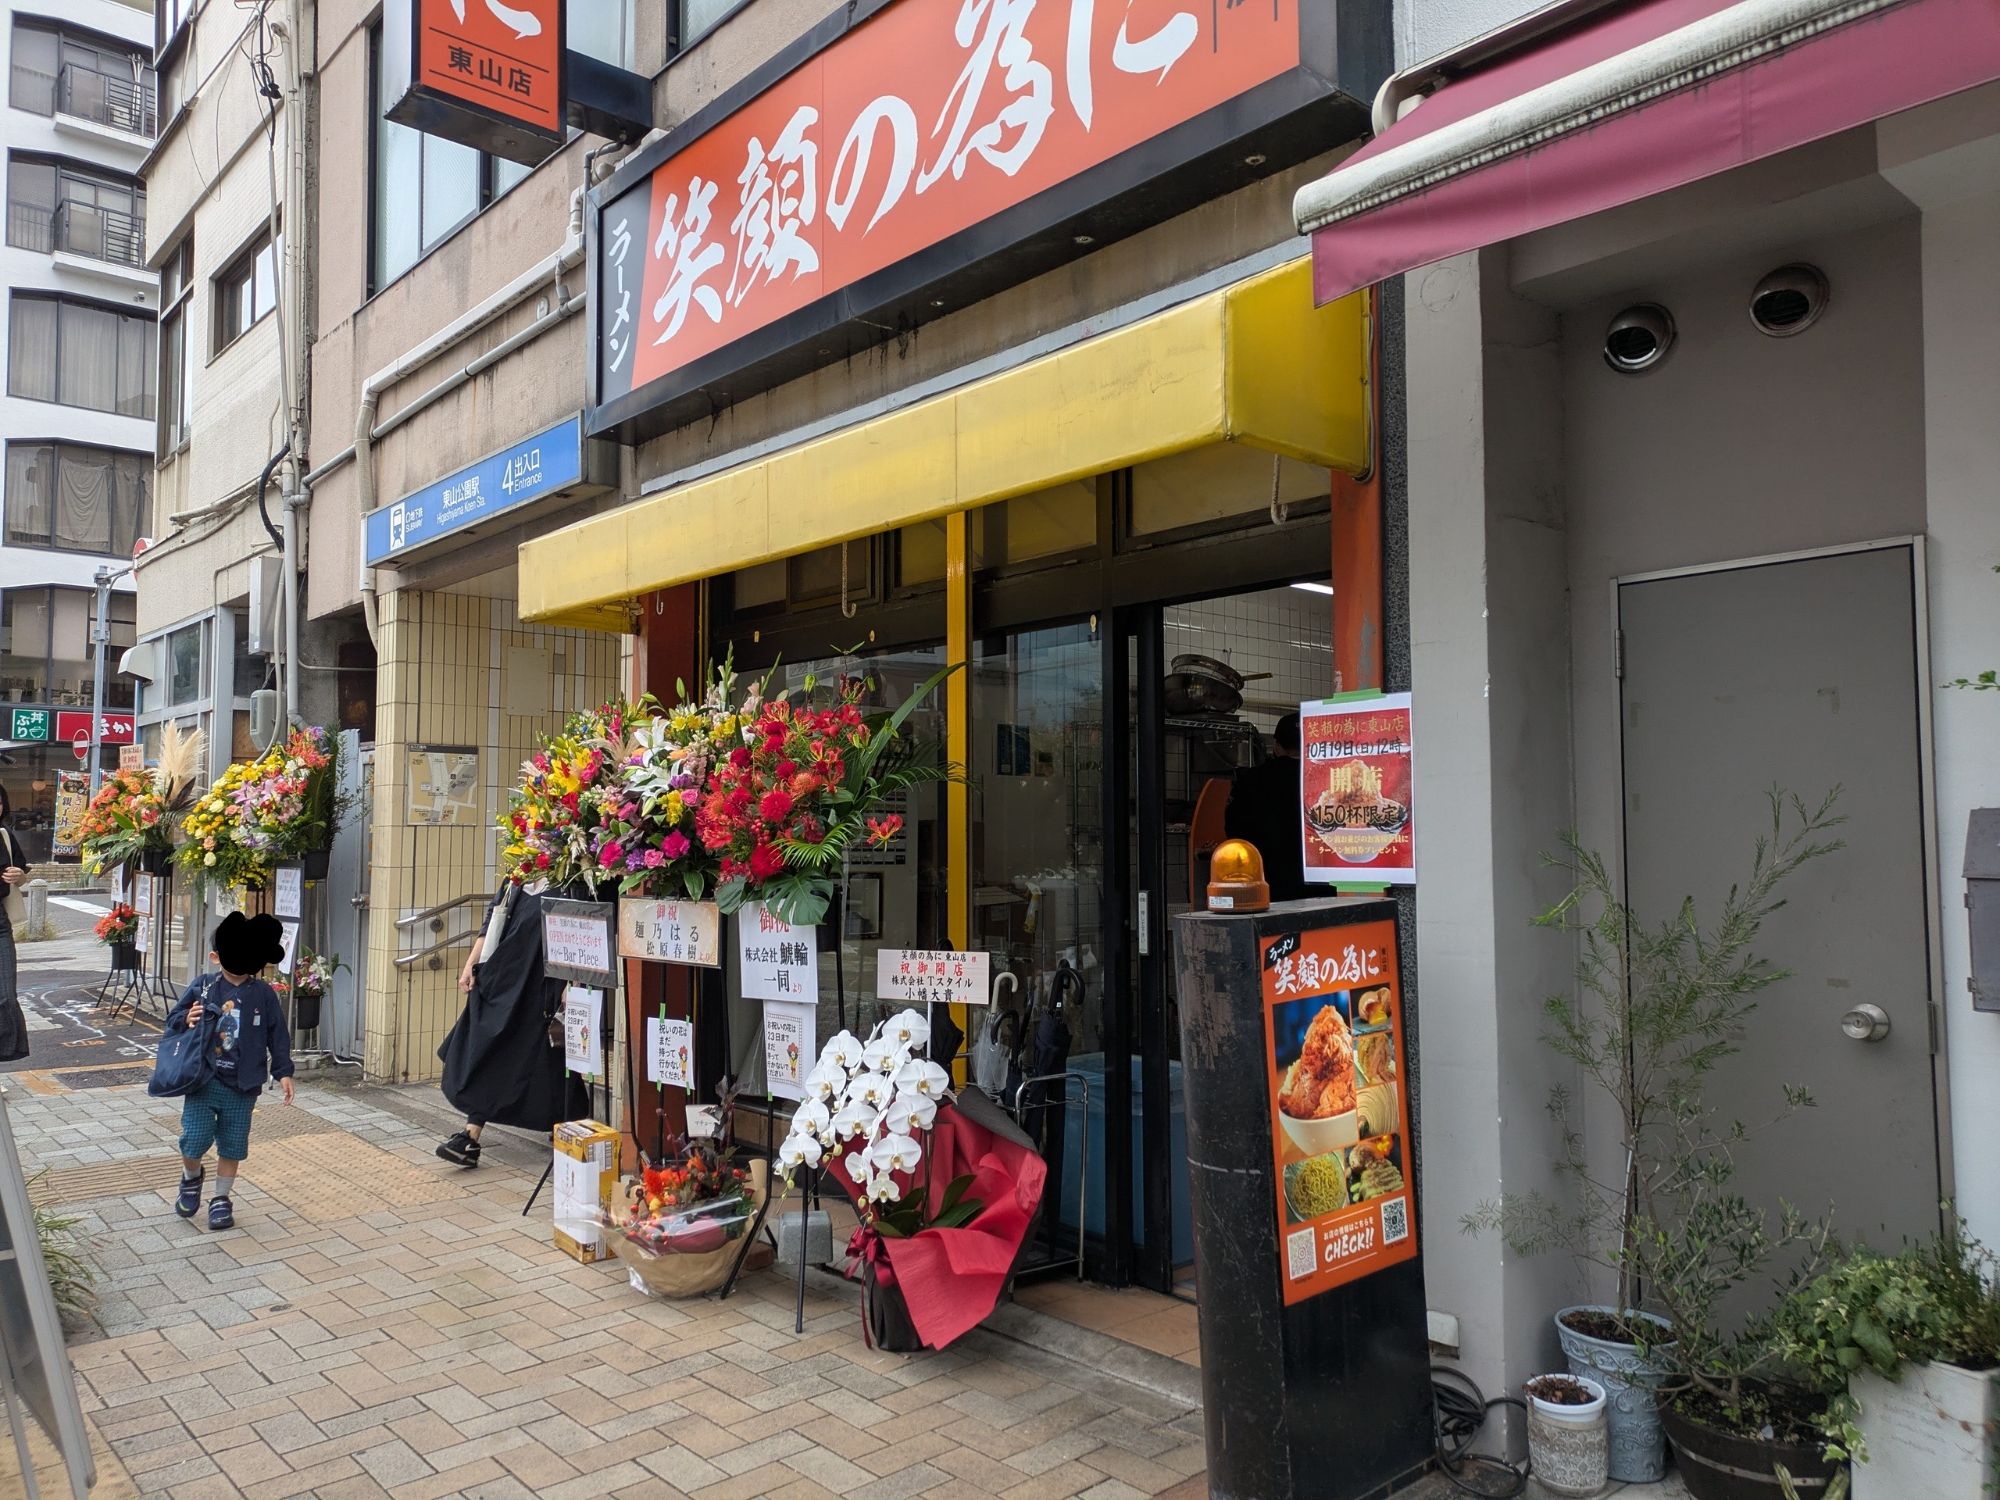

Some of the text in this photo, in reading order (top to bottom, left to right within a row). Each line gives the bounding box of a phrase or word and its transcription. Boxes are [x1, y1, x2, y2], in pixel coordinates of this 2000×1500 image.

[447, 45, 532, 97] 東山店
[608, 217, 632, 373] ラーメン
[502, 448, 540, 496] 4 出入口
[514, 472, 542, 493] Entrance
[442, 475, 480, 510] 東山公園駅
[1330, 765, 1384, 794] 開店
[1315, 804, 1400, 826] 150杯限定
[656, 903, 677, 921] 御祝
[635, 920, 699, 943] 麺乃はる
[578, 948, 599, 967] Piece
[646, 940, 697, 960] 松原春樹
[745, 946, 778, 963] 株式会社
[901, 950, 942, 961] 笑顔の為に
[945, 951, 967, 963] 東山店
[1269, 936, 1294, 962] ラーメン
[900, 961, 964, 977] 祝御開店
[1274, 944, 1380, 995] 笑顔の為に
[764, 969, 802, 993] 一同 より
[892, 974, 924, 986] 株式会社
[659, 1036, 671, 1046] まだ
[658, 1047, 676, 1058] 持って
[659, 1058, 679, 1070] 行かない
[659, 1070, 682, 1081] でください
[1324, 1227, 1375, 1263] CHECK!!
